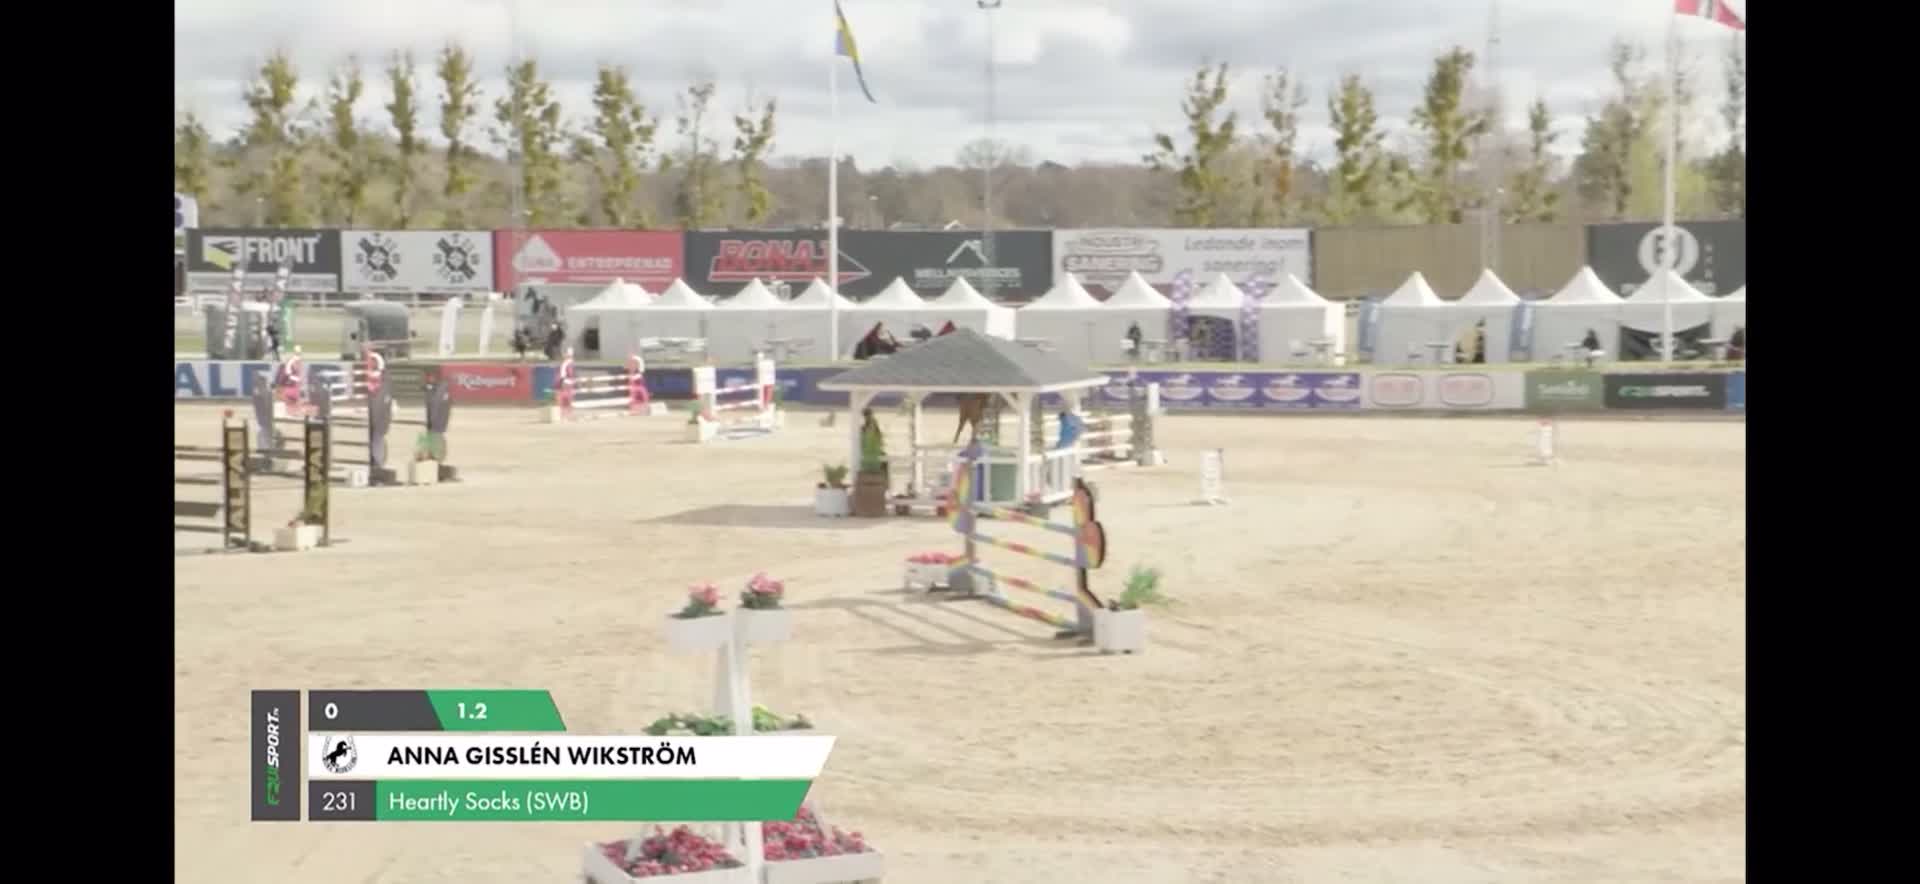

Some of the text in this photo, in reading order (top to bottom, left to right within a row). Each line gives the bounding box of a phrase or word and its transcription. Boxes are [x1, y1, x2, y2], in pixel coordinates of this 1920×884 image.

[245, 237, 318, 263] FRONT
[1184, 235, 1256, 252] Ledande
[566, 257, 673, 269] ENTREPRENAD
[718, 240, 834, 273] BONA
[1203, 256, 1286, 274] sanering!
